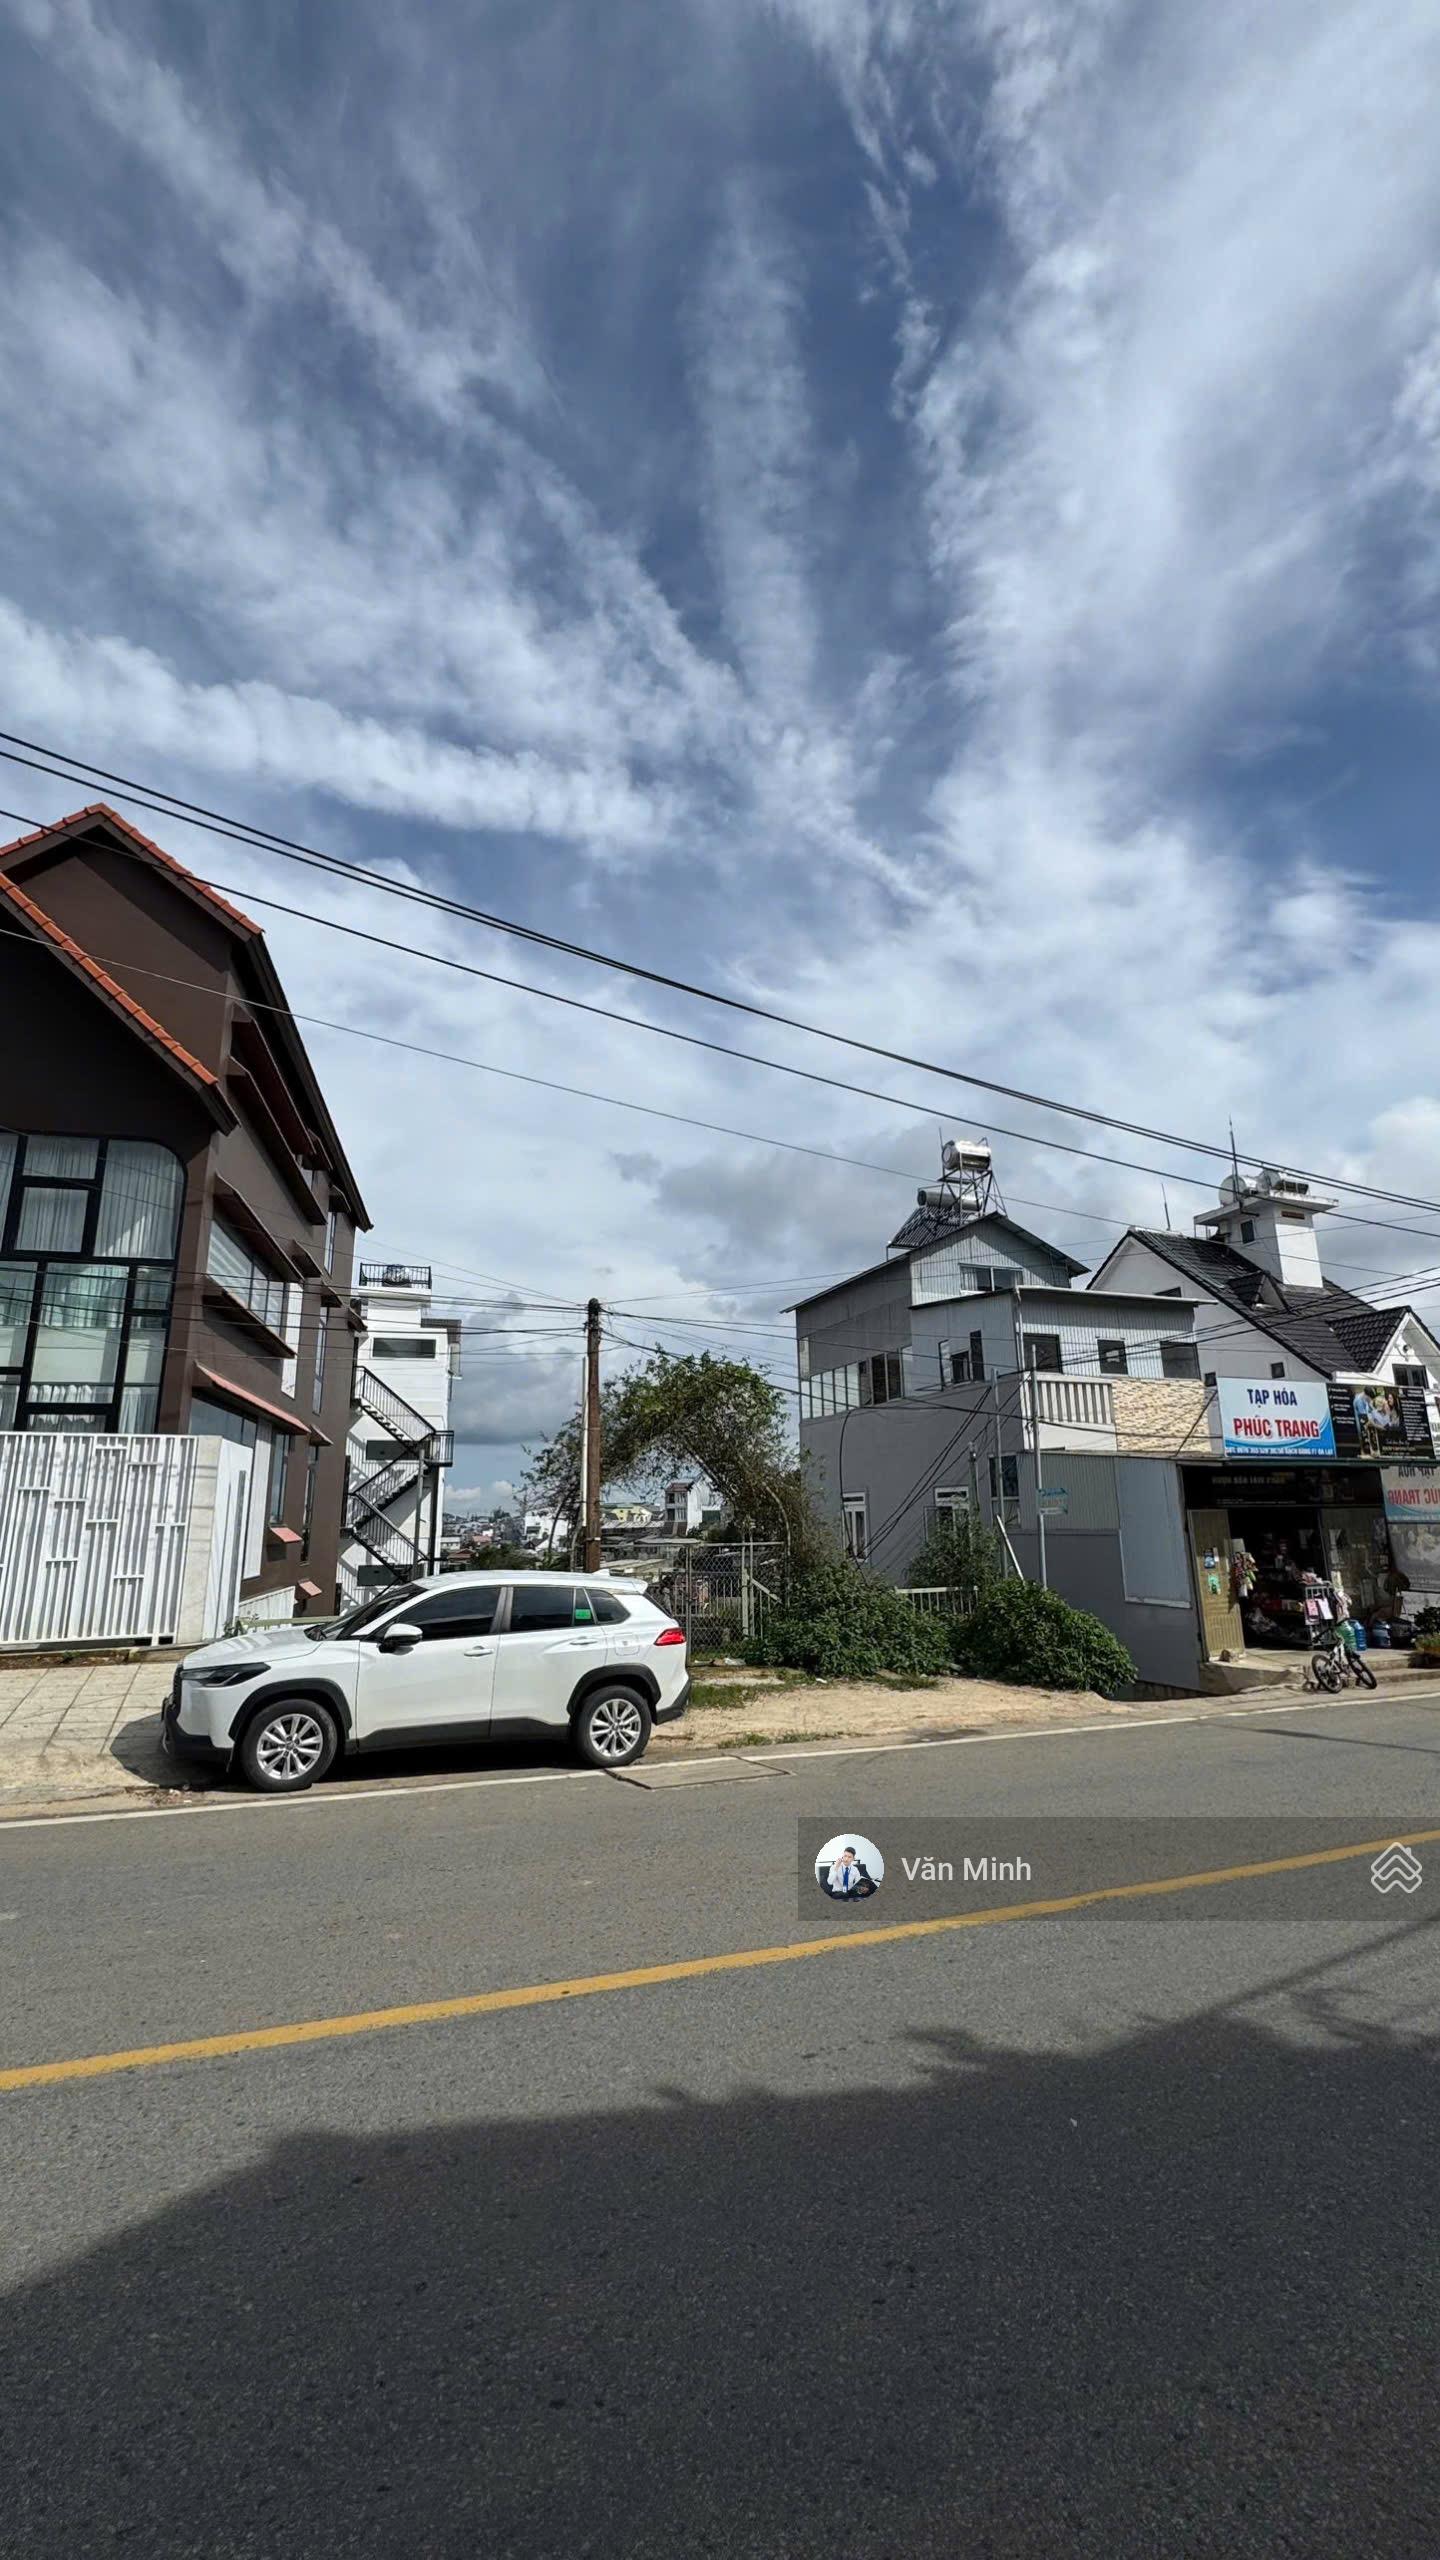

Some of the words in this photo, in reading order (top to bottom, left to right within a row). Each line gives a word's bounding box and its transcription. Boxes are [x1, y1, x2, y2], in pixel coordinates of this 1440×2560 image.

[1247, 1388, 1270, 1408] TẠP
[1273, 1387, 1297, 1406] HÓA
[1233, 1415, 1272, 1437] PHÚC
[1274, 1419, 1320, 1438] TRANG
